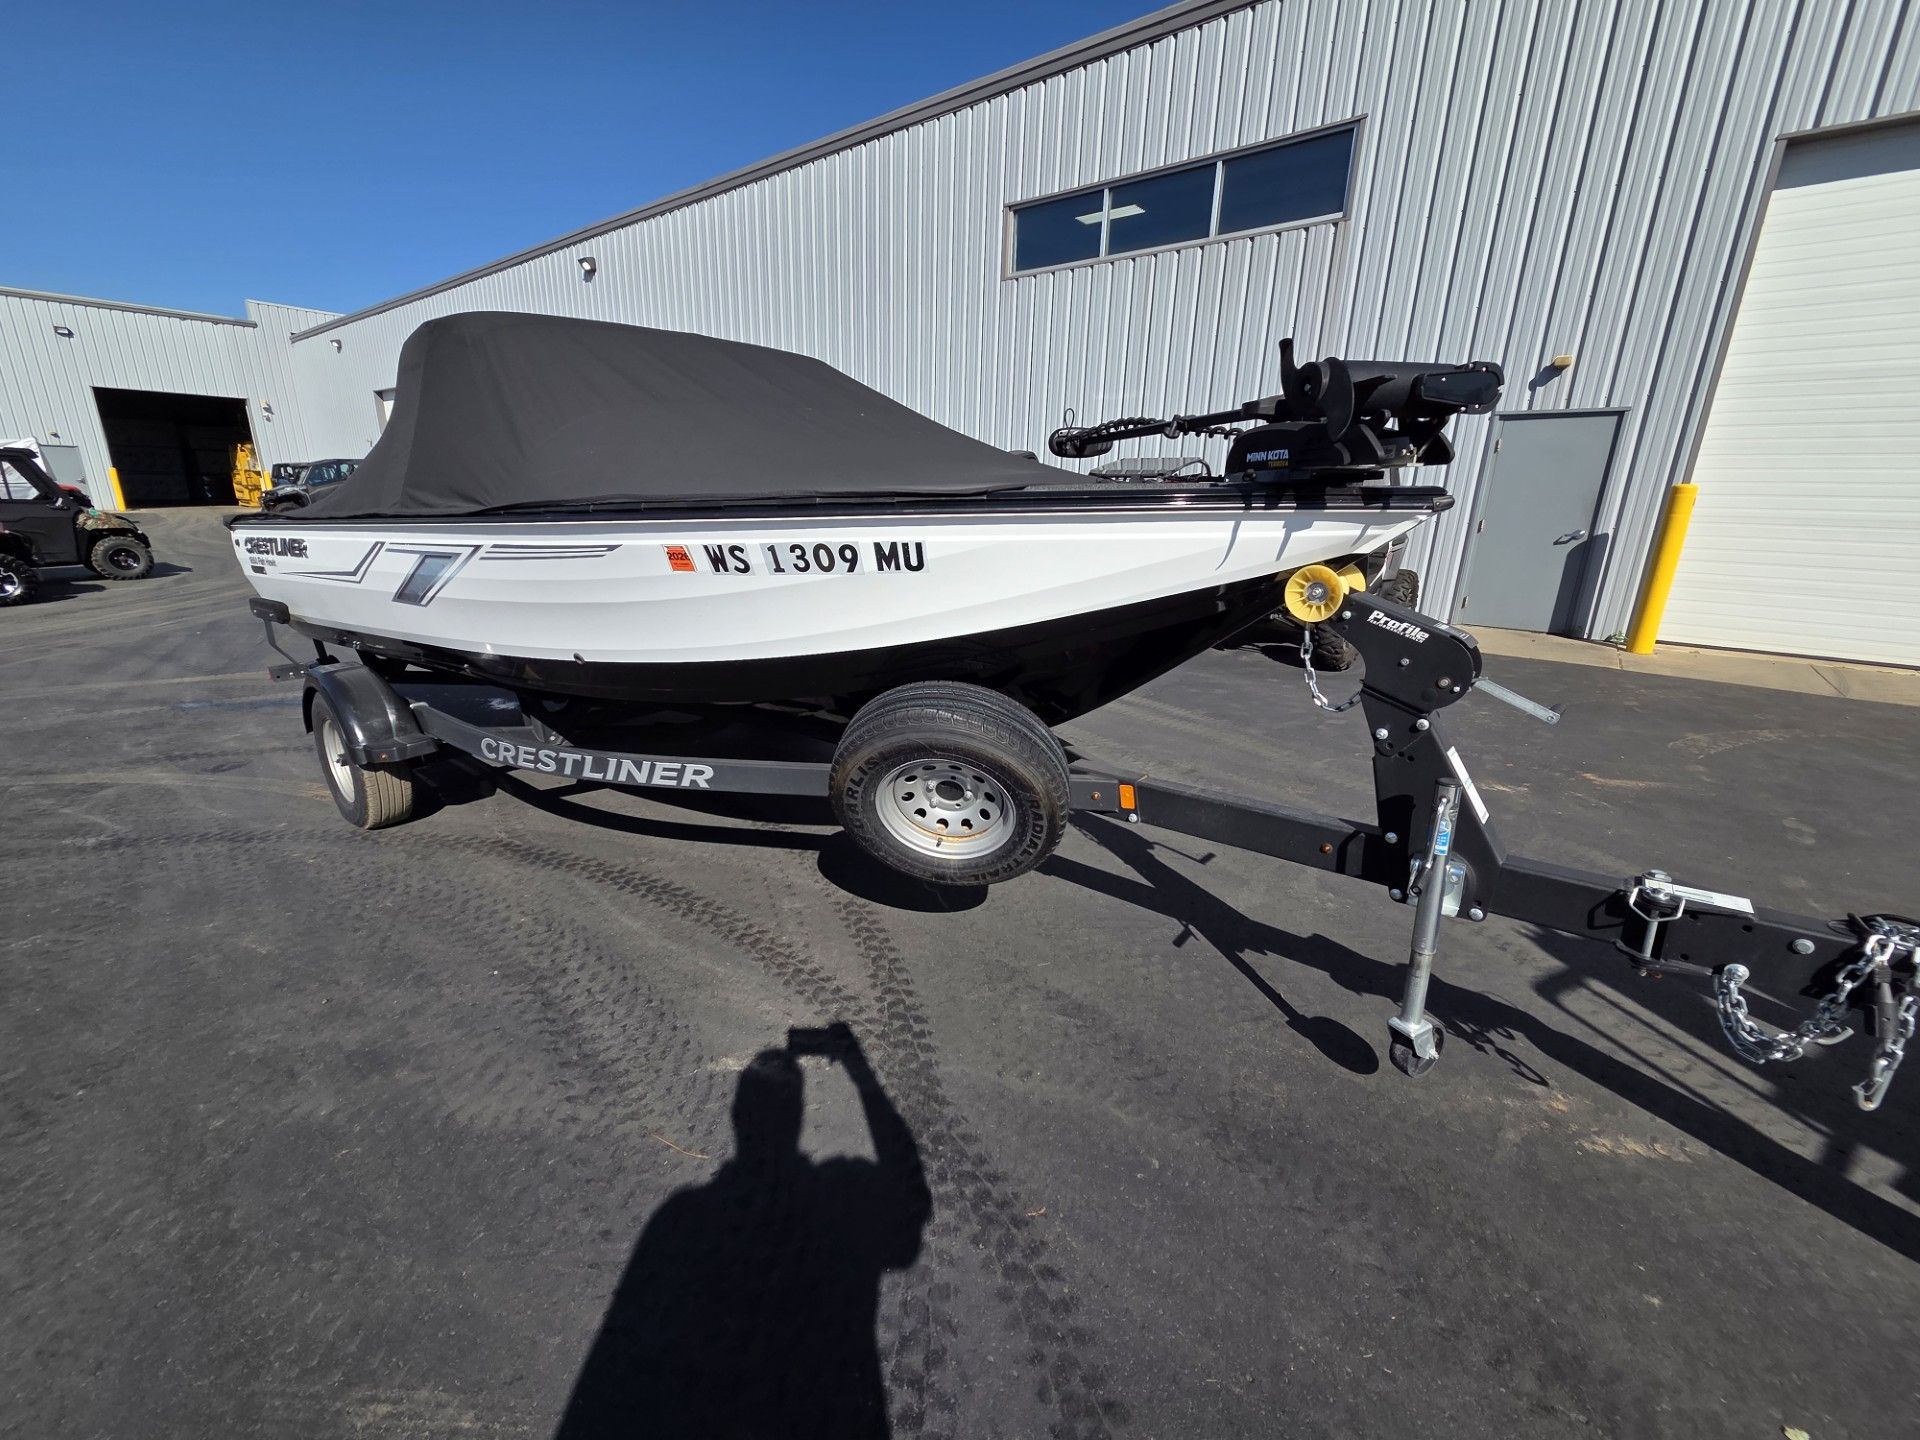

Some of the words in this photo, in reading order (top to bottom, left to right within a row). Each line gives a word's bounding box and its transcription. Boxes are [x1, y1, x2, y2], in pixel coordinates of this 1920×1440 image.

[1246, 451, 1267, 462] MINN
[1268, 449, 1288, 460] KOTA
[244, 536, 309, 559] CRESTLINER
[703, 544, 751, 573] WS
[767, 543, 859, 573] 1309
[874, 541, 925, 572] MU
[1368, 610, 1430, 639] Profile
[480, 737, 715, 789] CRESTLINER
